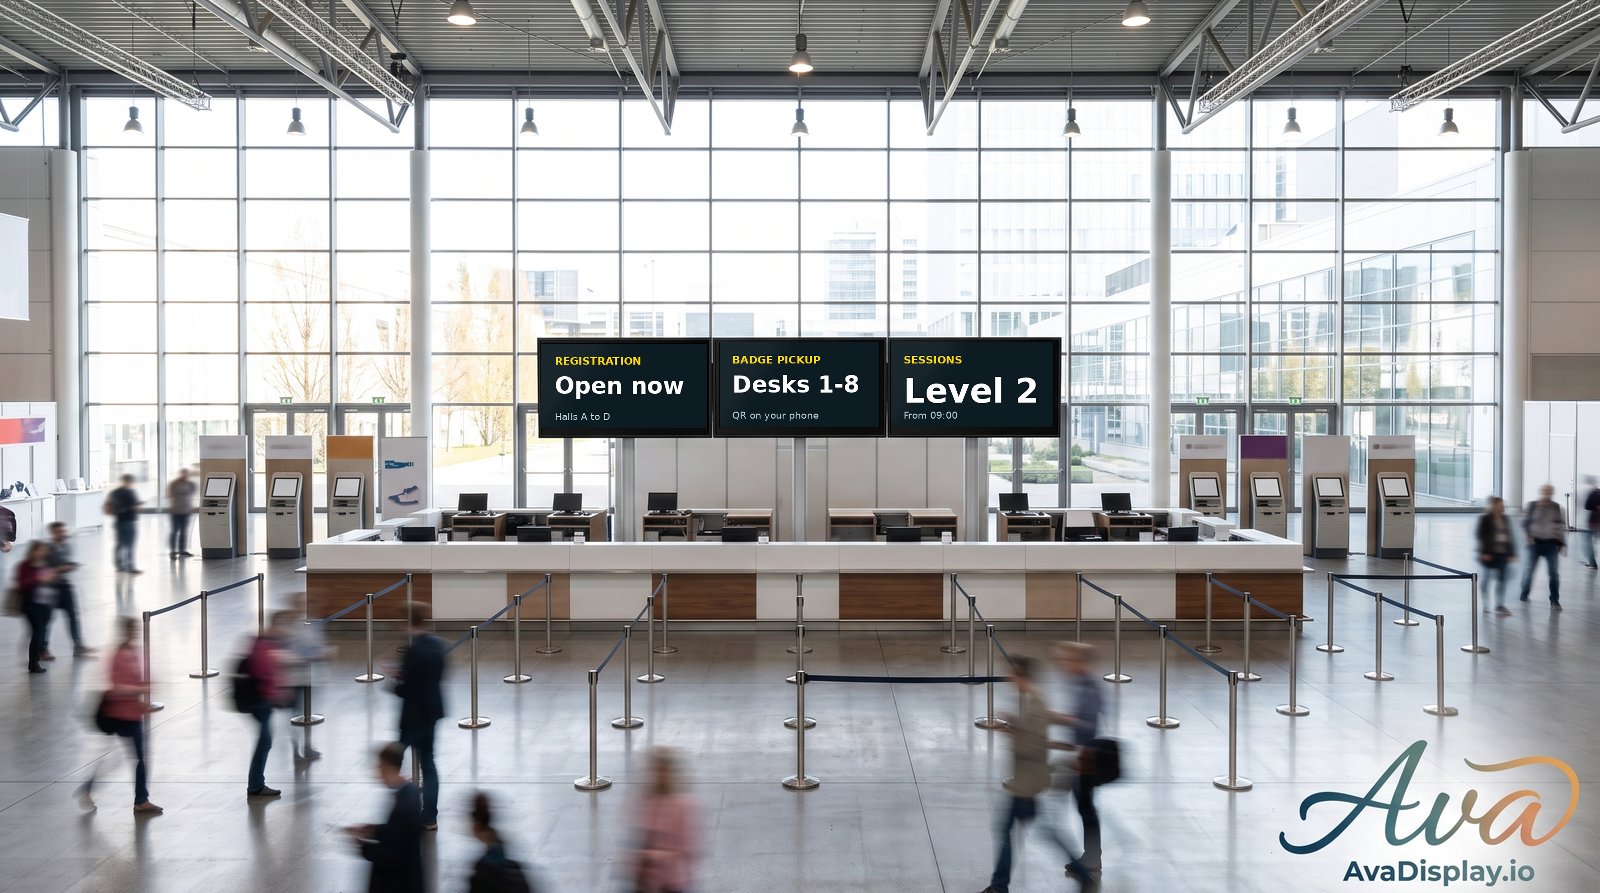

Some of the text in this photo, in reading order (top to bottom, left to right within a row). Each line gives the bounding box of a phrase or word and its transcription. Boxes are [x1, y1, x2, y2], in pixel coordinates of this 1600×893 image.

[555, 356, 641, 366] REGISTRATION
[732, 355, 821, 365] BADGE PICKUP
[903, 355, 963, 365] SESSIONS
[555, 375, 684, 400] Open now
[733, 374, 859, 394] Desks 1-8
[905, 376, 1037, 404] Level 2
[555, 412, 611, 421] Halls A to D
[732, 411, 747, 421] QR
[764, 413, 787, 422] your
[790, 411, 819, 422] phone
[903, 411, 958, 420] From 09:00
